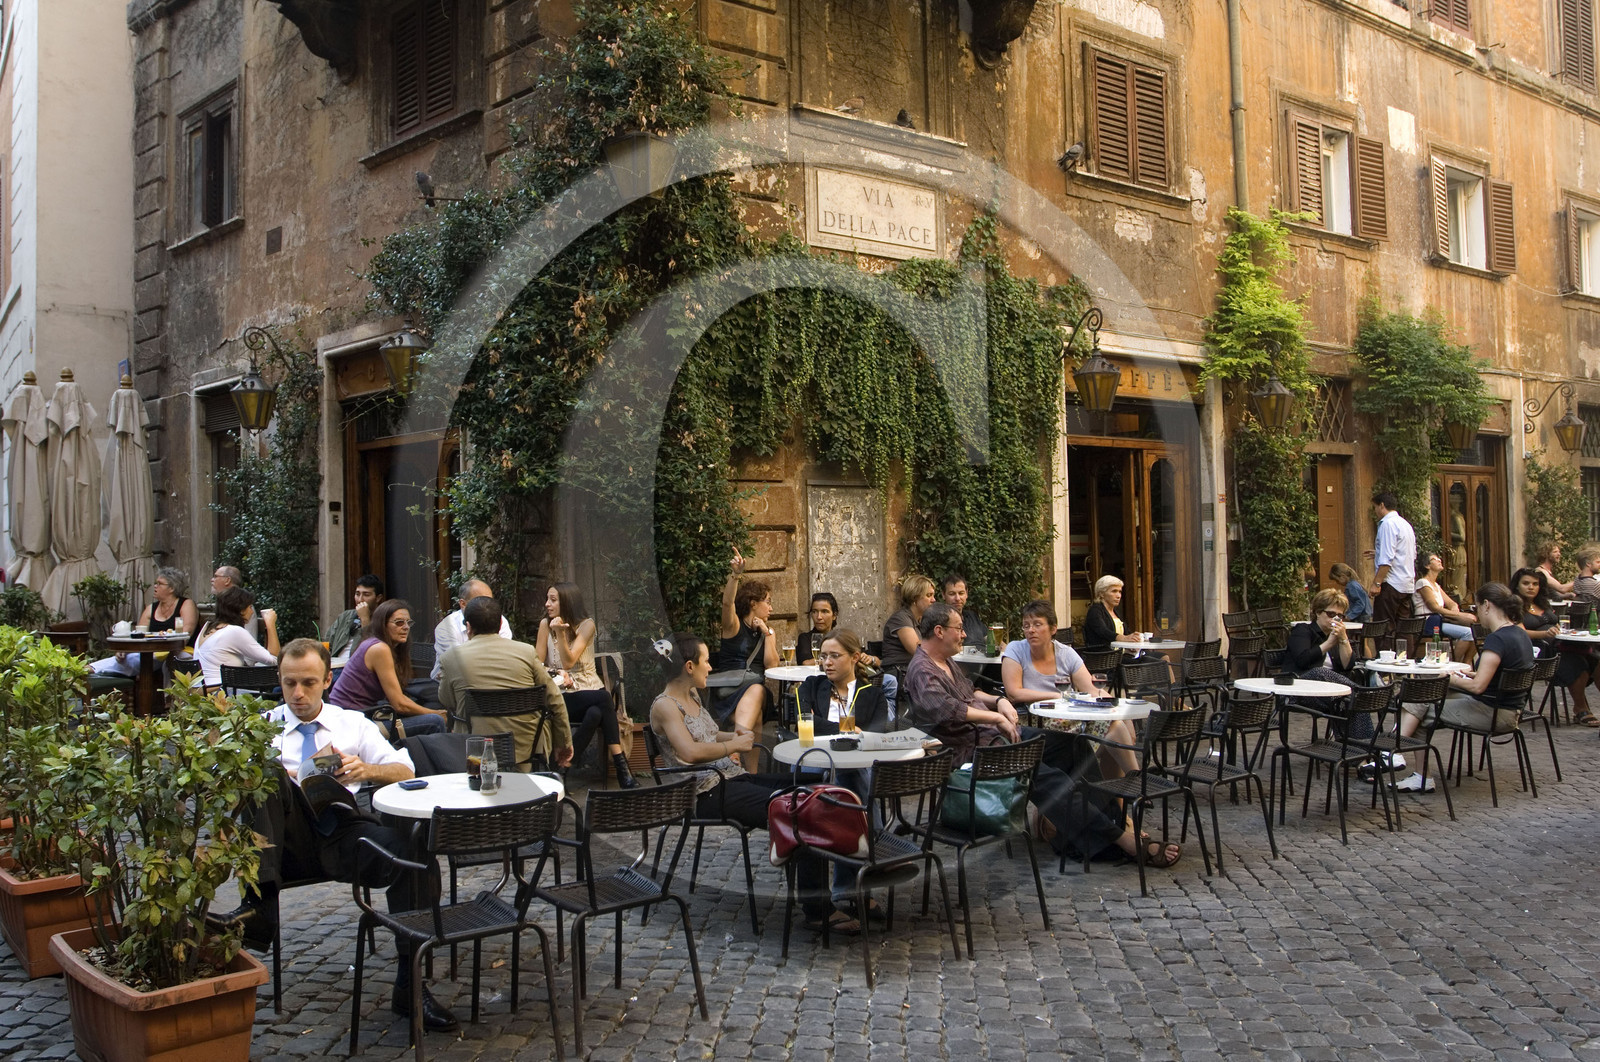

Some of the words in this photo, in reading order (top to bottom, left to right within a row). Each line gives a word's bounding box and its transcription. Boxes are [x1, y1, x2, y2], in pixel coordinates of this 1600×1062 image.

[863, 186, 894, 208] VIA
[823, 210, 879, 236] DELLA
[888, 221, 932, 245] PACE
[1118, 368, 1173, 391] FFÈ
